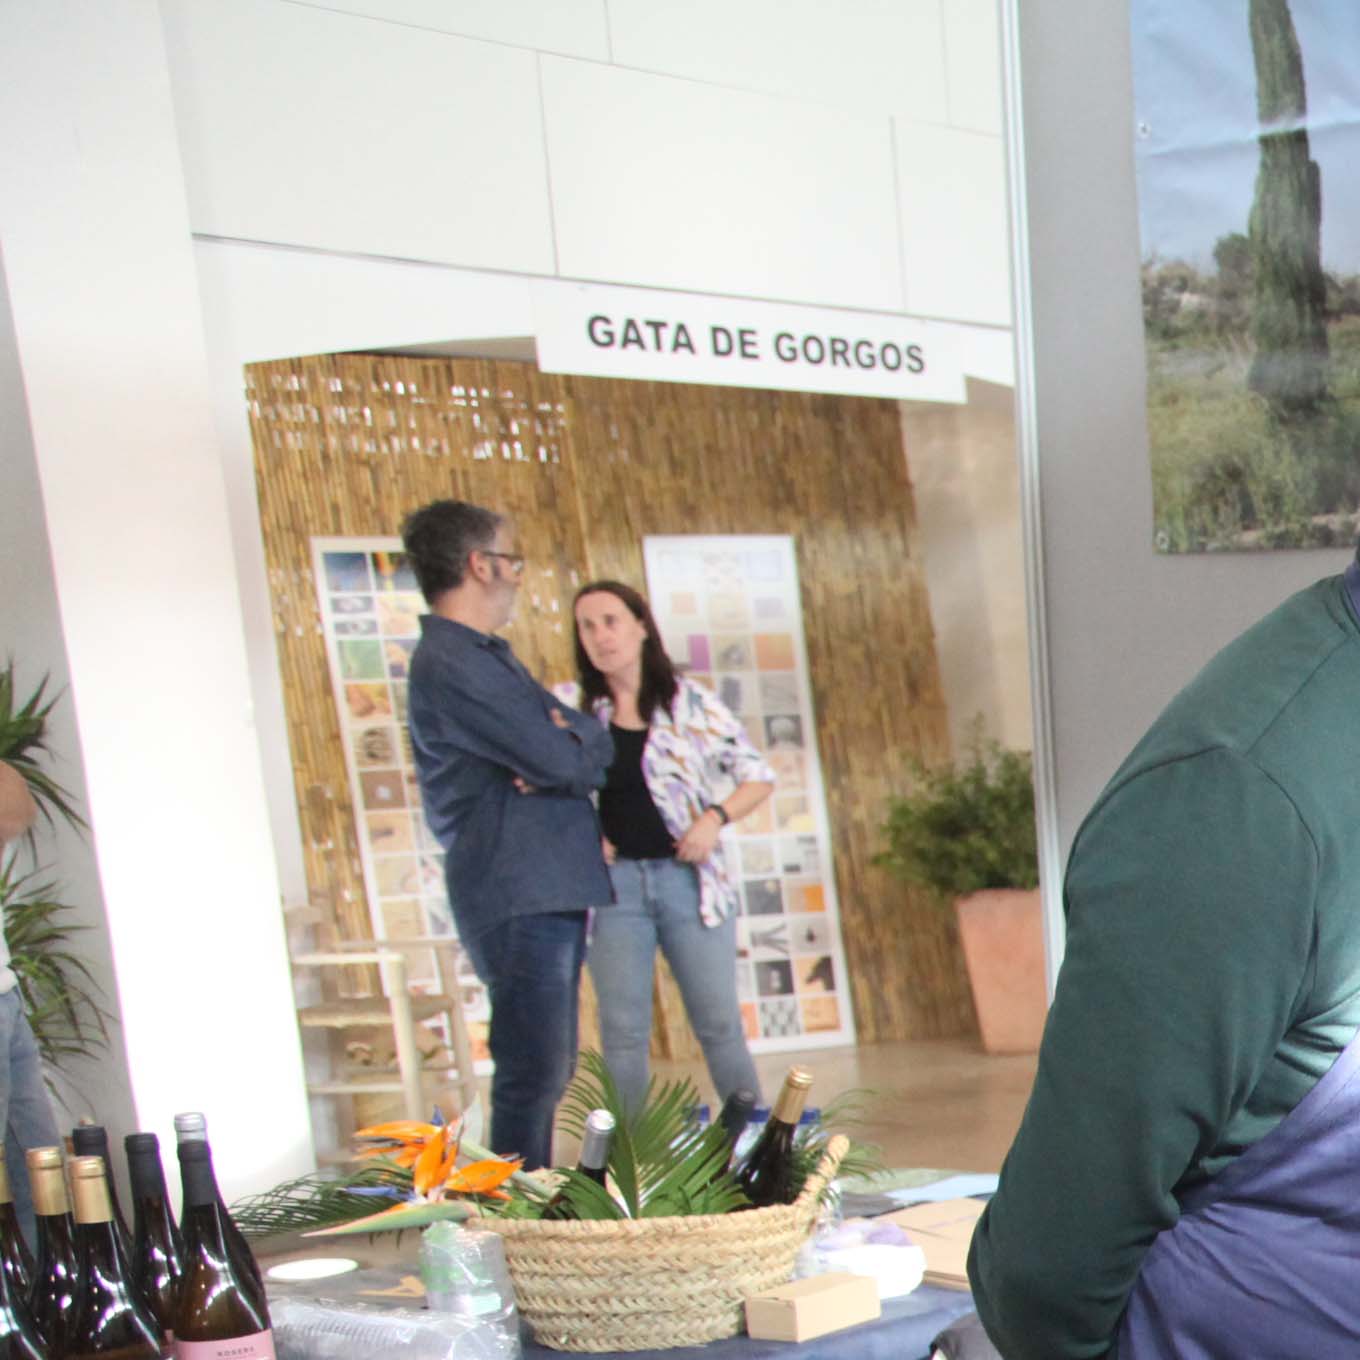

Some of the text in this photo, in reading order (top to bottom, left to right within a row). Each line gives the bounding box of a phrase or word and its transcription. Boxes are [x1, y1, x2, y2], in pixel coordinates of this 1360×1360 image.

[586, 315, 925, 374] GATA DE GORGOS
